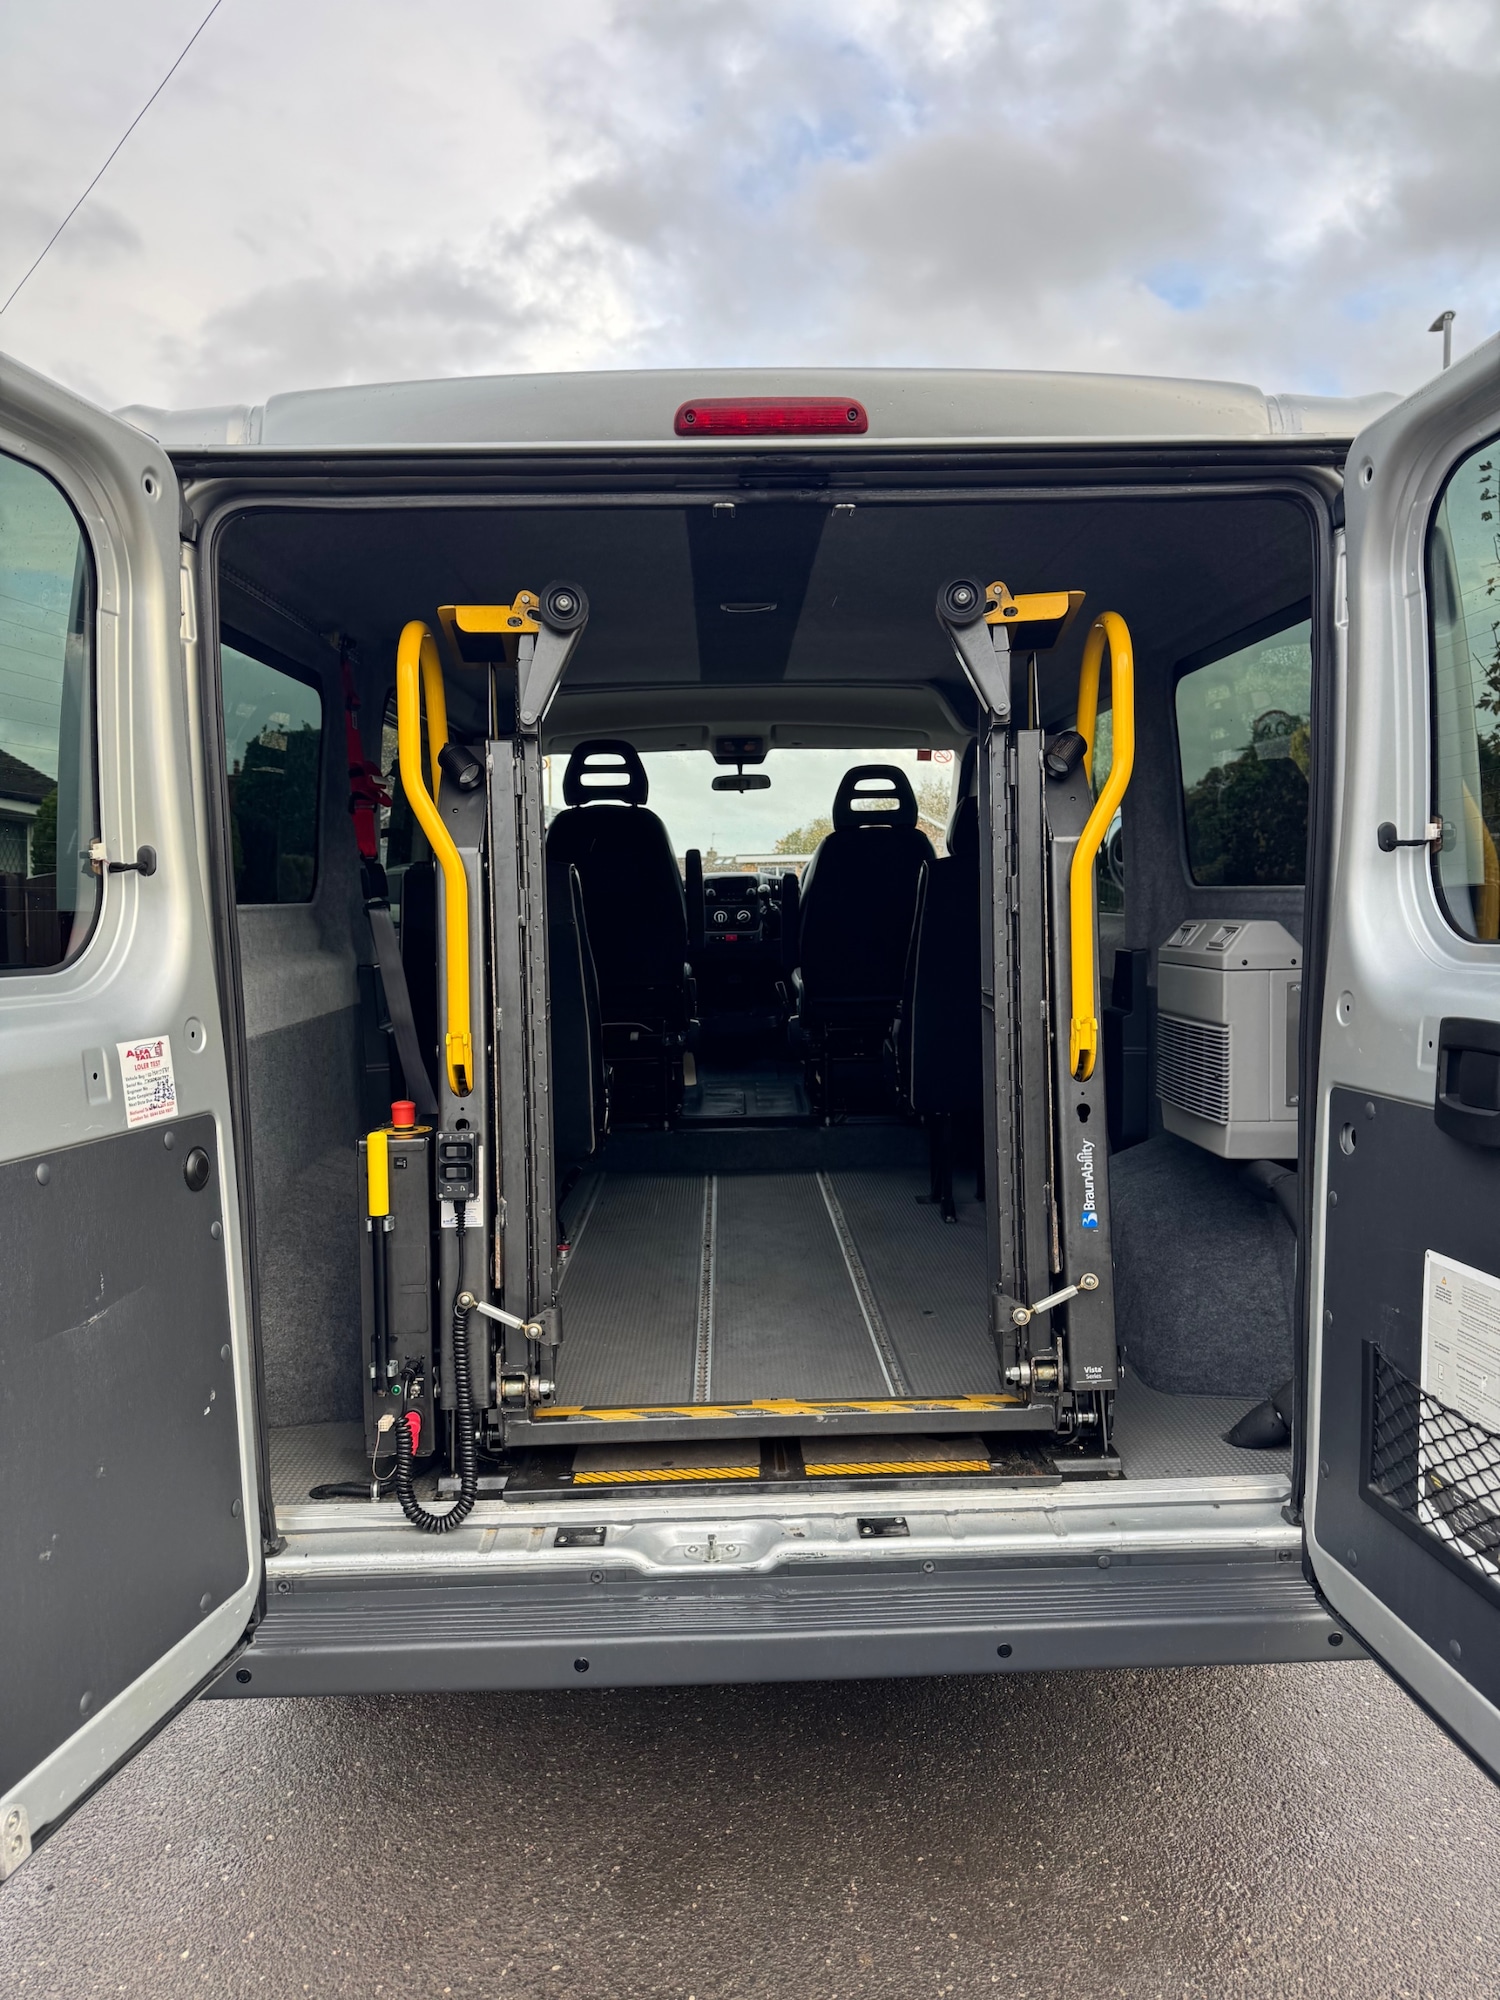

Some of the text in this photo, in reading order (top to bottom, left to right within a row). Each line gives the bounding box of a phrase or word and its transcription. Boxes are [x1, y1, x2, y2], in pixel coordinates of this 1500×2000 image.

[126, 1048, 151, 1058] ALFA
[134, 1062, 149, 1070] LOLER
[1077, 1139, 1095, 1211] BraunAbility
[1083, 1366, 1103, 1374] Vista
